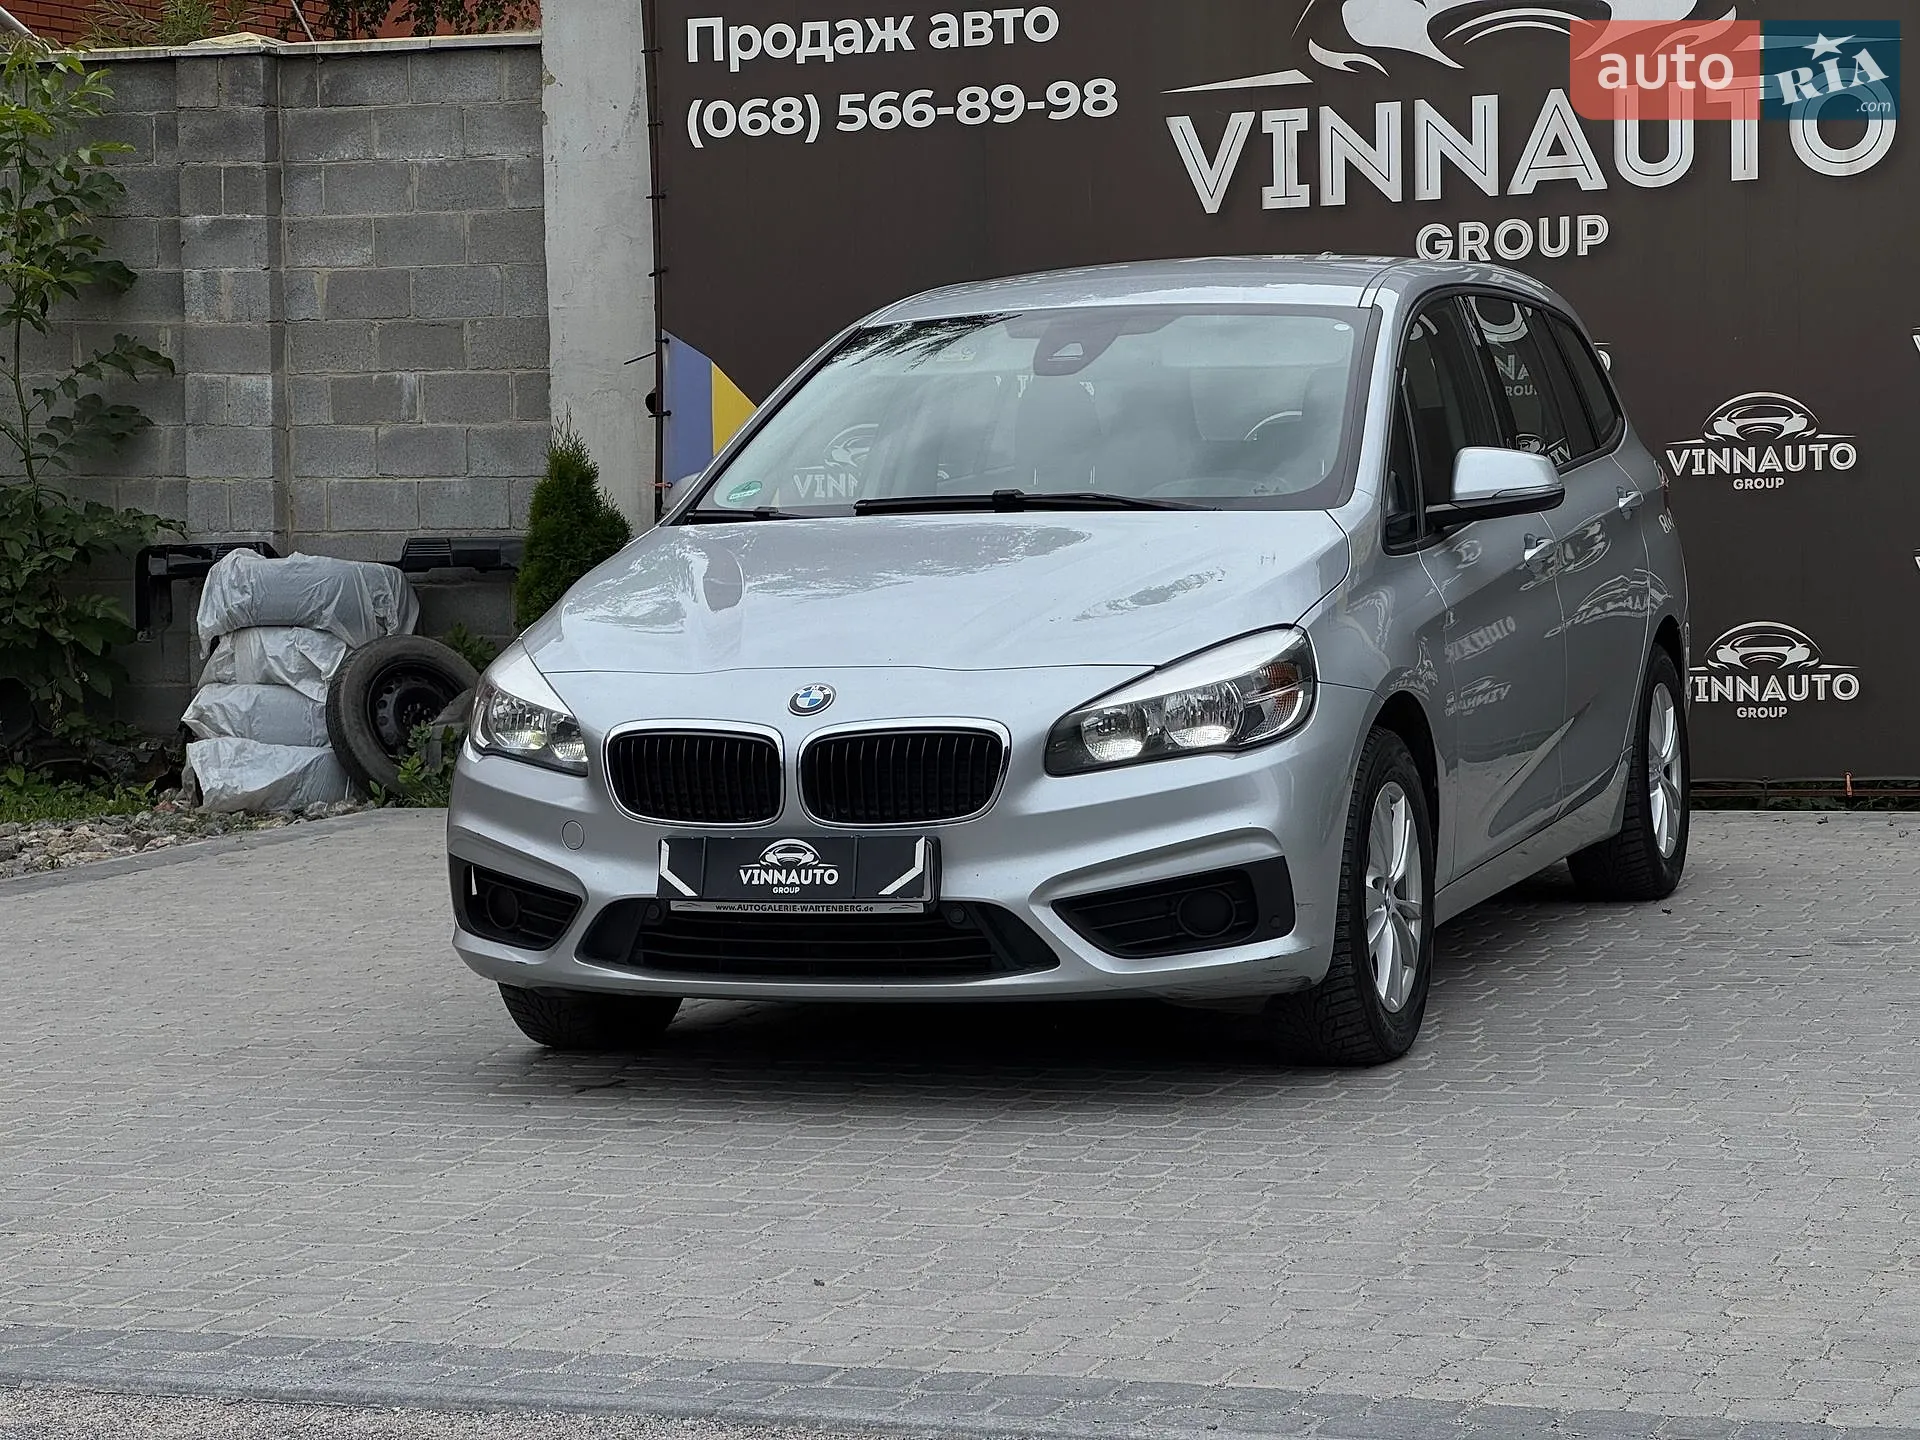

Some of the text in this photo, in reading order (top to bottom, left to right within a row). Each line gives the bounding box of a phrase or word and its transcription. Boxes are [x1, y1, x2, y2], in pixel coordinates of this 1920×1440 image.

[687, 6, 1060, 73] Продаж авто
[687, 77, 1119, 149] (068) 566-89-98
[1165, 67, 1898, 214] VINNAUTO
[1415, 214, 1609, 261] GROUP
[1666, 443, 1857, 477] VINNAUTO
[1733, 477, 1785, 490] GROUP
[1736, 706, 1788, 719] GROUP
[739, 868, 839, 885] VINNAUTO
[772, 886, 800, 894] GROUP
